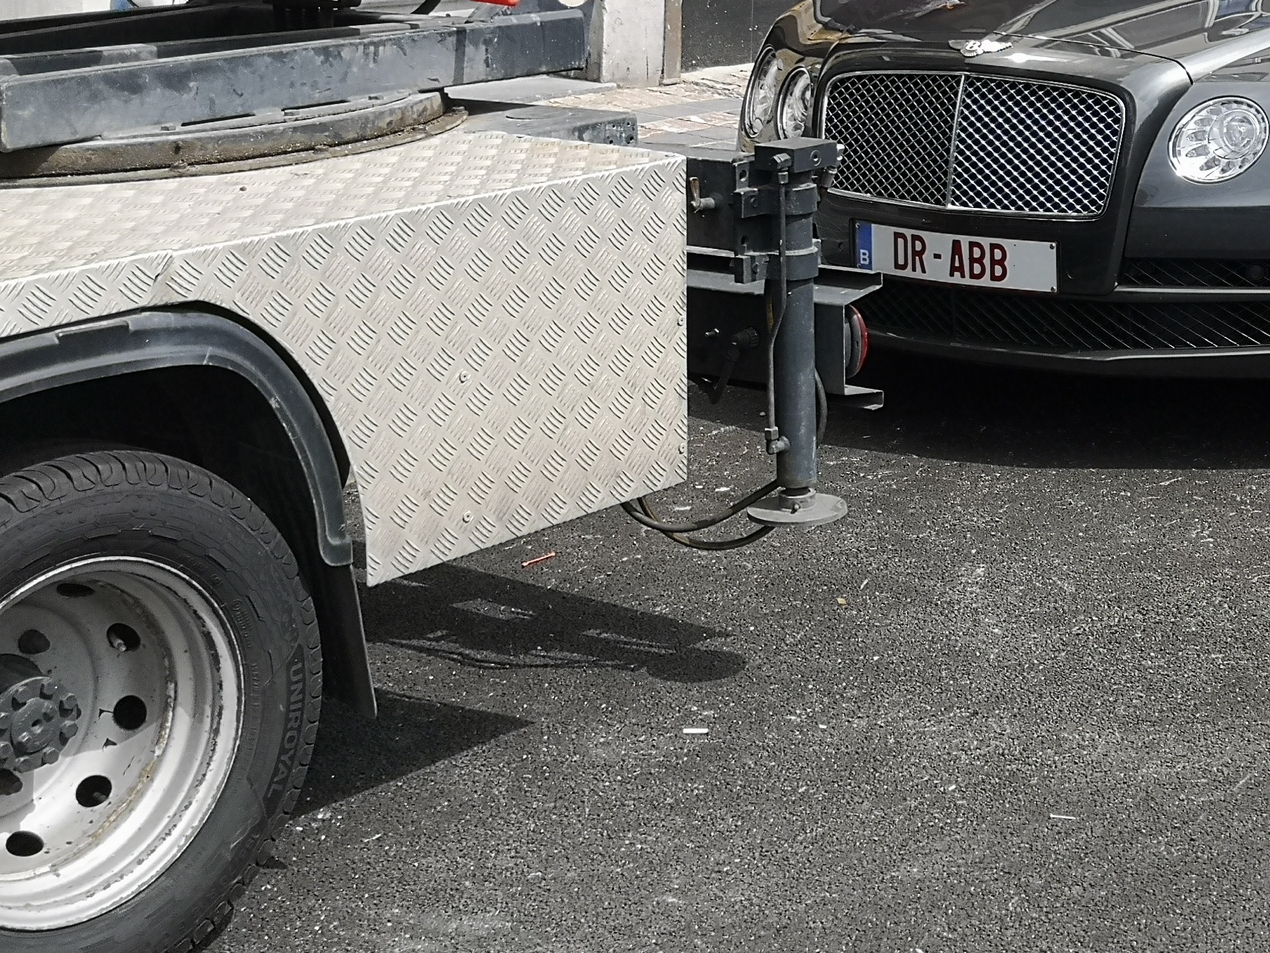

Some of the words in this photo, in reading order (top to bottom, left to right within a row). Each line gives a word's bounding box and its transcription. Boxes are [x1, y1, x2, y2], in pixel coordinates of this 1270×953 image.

[859, 249, 870, 265] B
[893, 231, 1008, 282] DR-ABB
[267, 662, 304, 798] UNIROYAL
